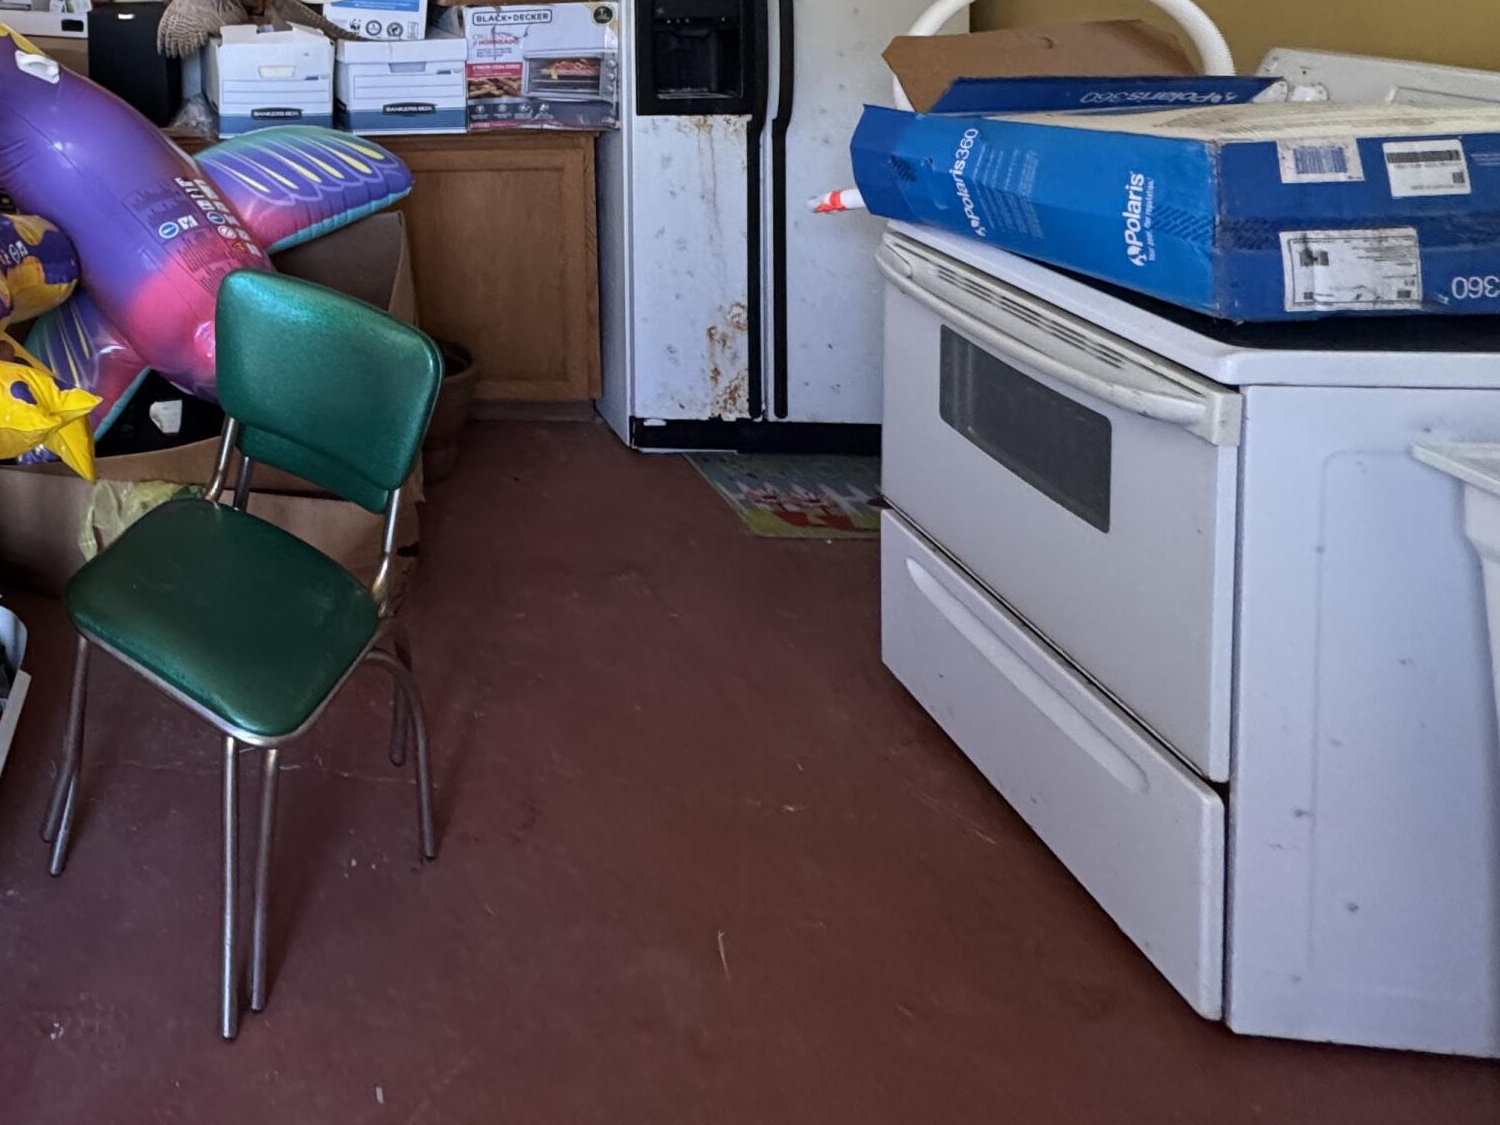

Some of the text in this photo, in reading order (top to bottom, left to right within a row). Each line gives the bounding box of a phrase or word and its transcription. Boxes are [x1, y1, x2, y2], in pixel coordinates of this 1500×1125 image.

[476, 12, 549, 23] BLACK+DECKER
[949, 128, 982, 222] Polaris360
[1122, 172, 1145, 247] Polaris
